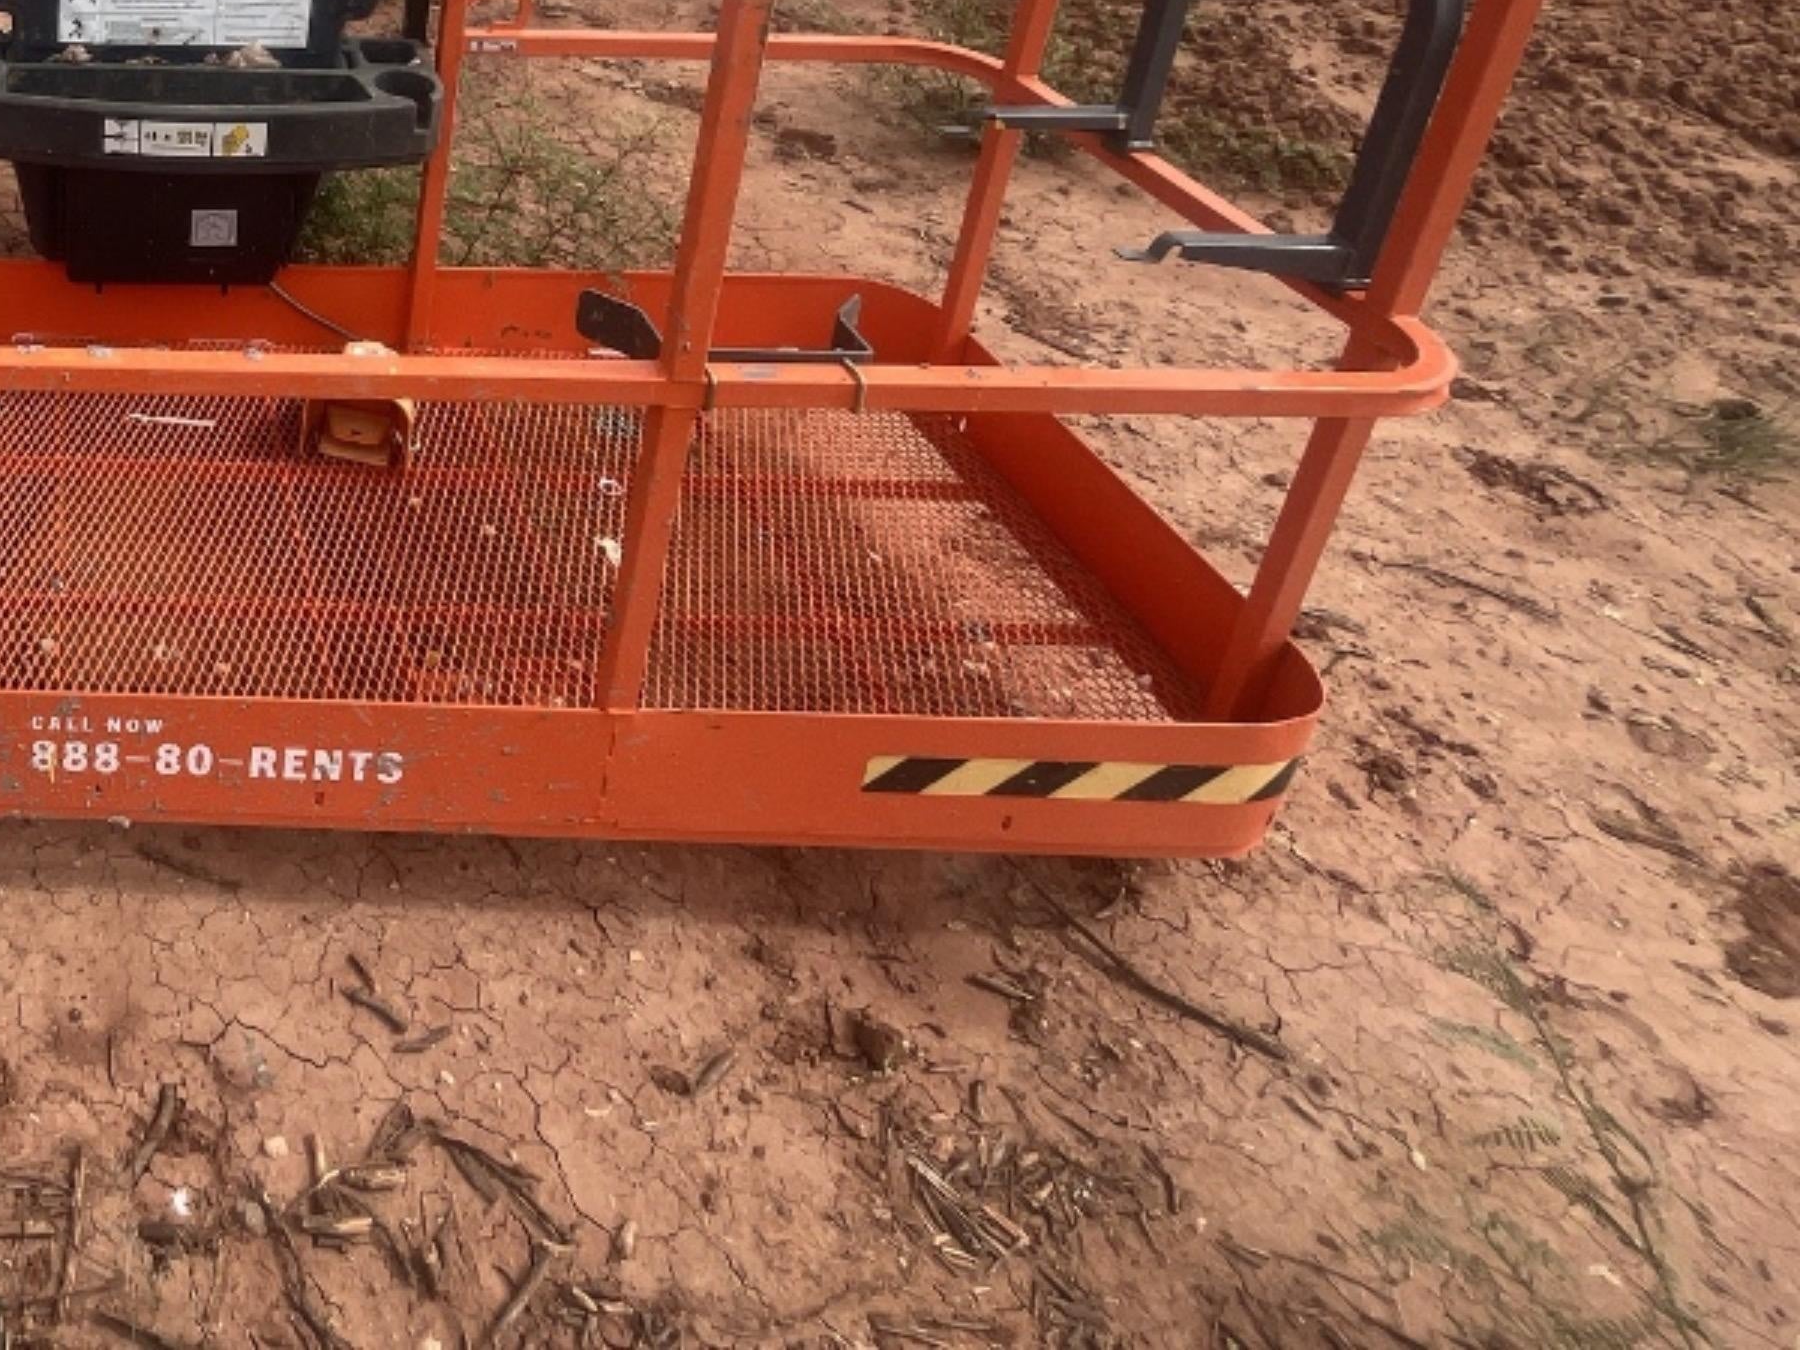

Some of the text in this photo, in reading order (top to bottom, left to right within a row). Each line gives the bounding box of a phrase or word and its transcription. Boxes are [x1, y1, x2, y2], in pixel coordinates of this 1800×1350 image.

[31, 715, 164, 734] CALL NOW
[31, 739, 404, 784] 888-80-RENTS
